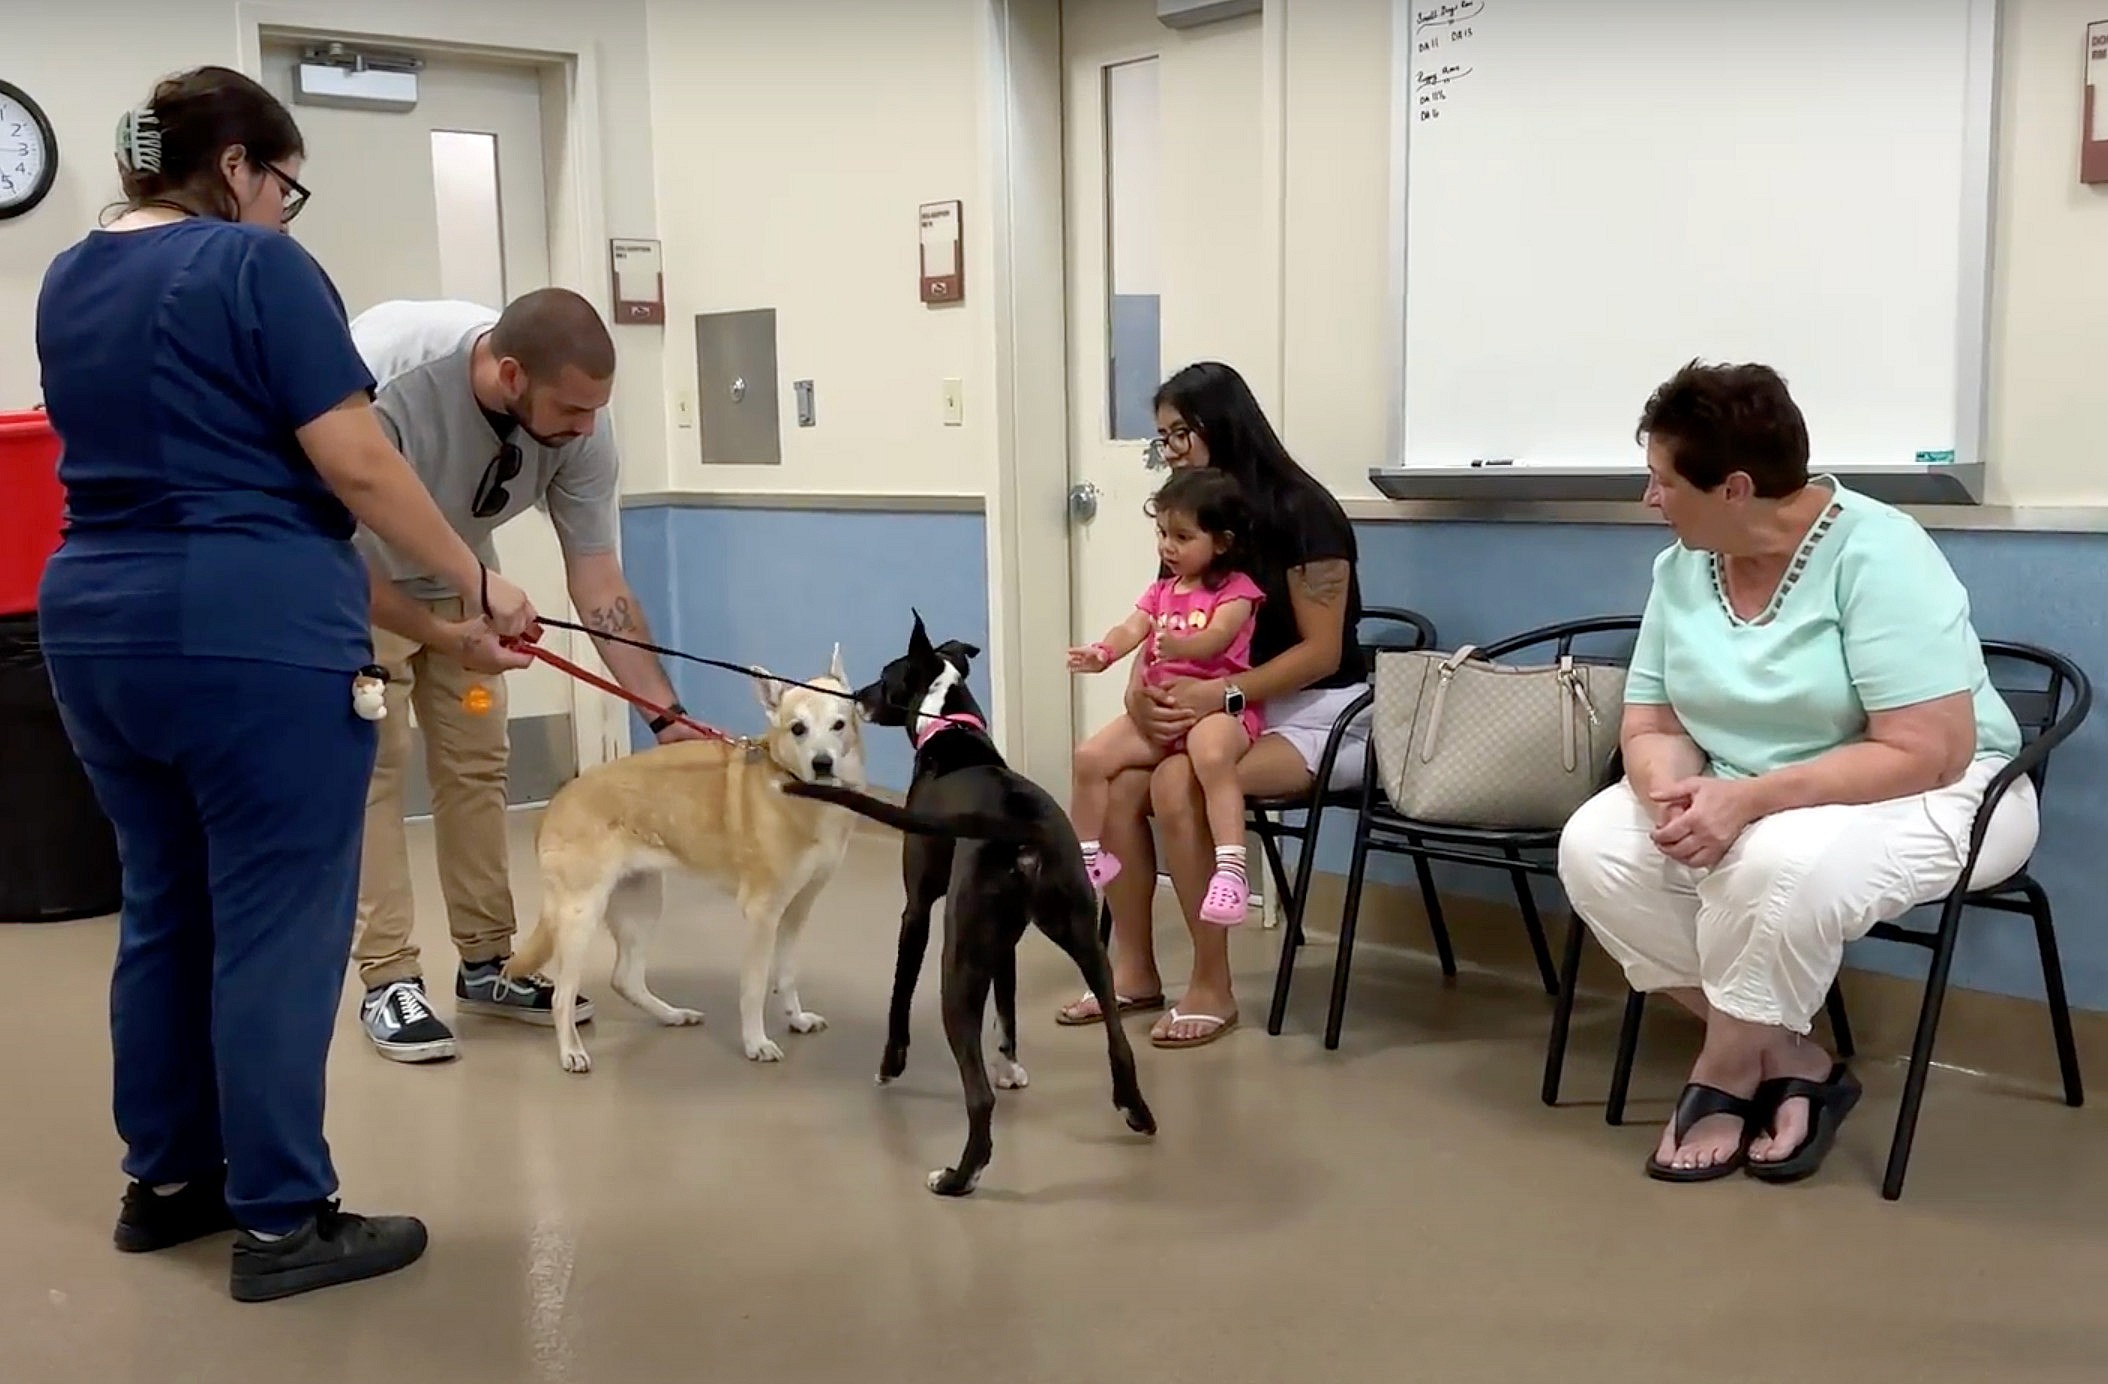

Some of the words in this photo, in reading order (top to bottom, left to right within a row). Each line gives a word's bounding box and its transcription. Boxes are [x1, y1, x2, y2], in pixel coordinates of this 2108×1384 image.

[11, 122, 22, 137] 2
[18, 142, 29, 157] 3
[15, 161, 26, 175] 4
[1, 174, 14, 190] 5
